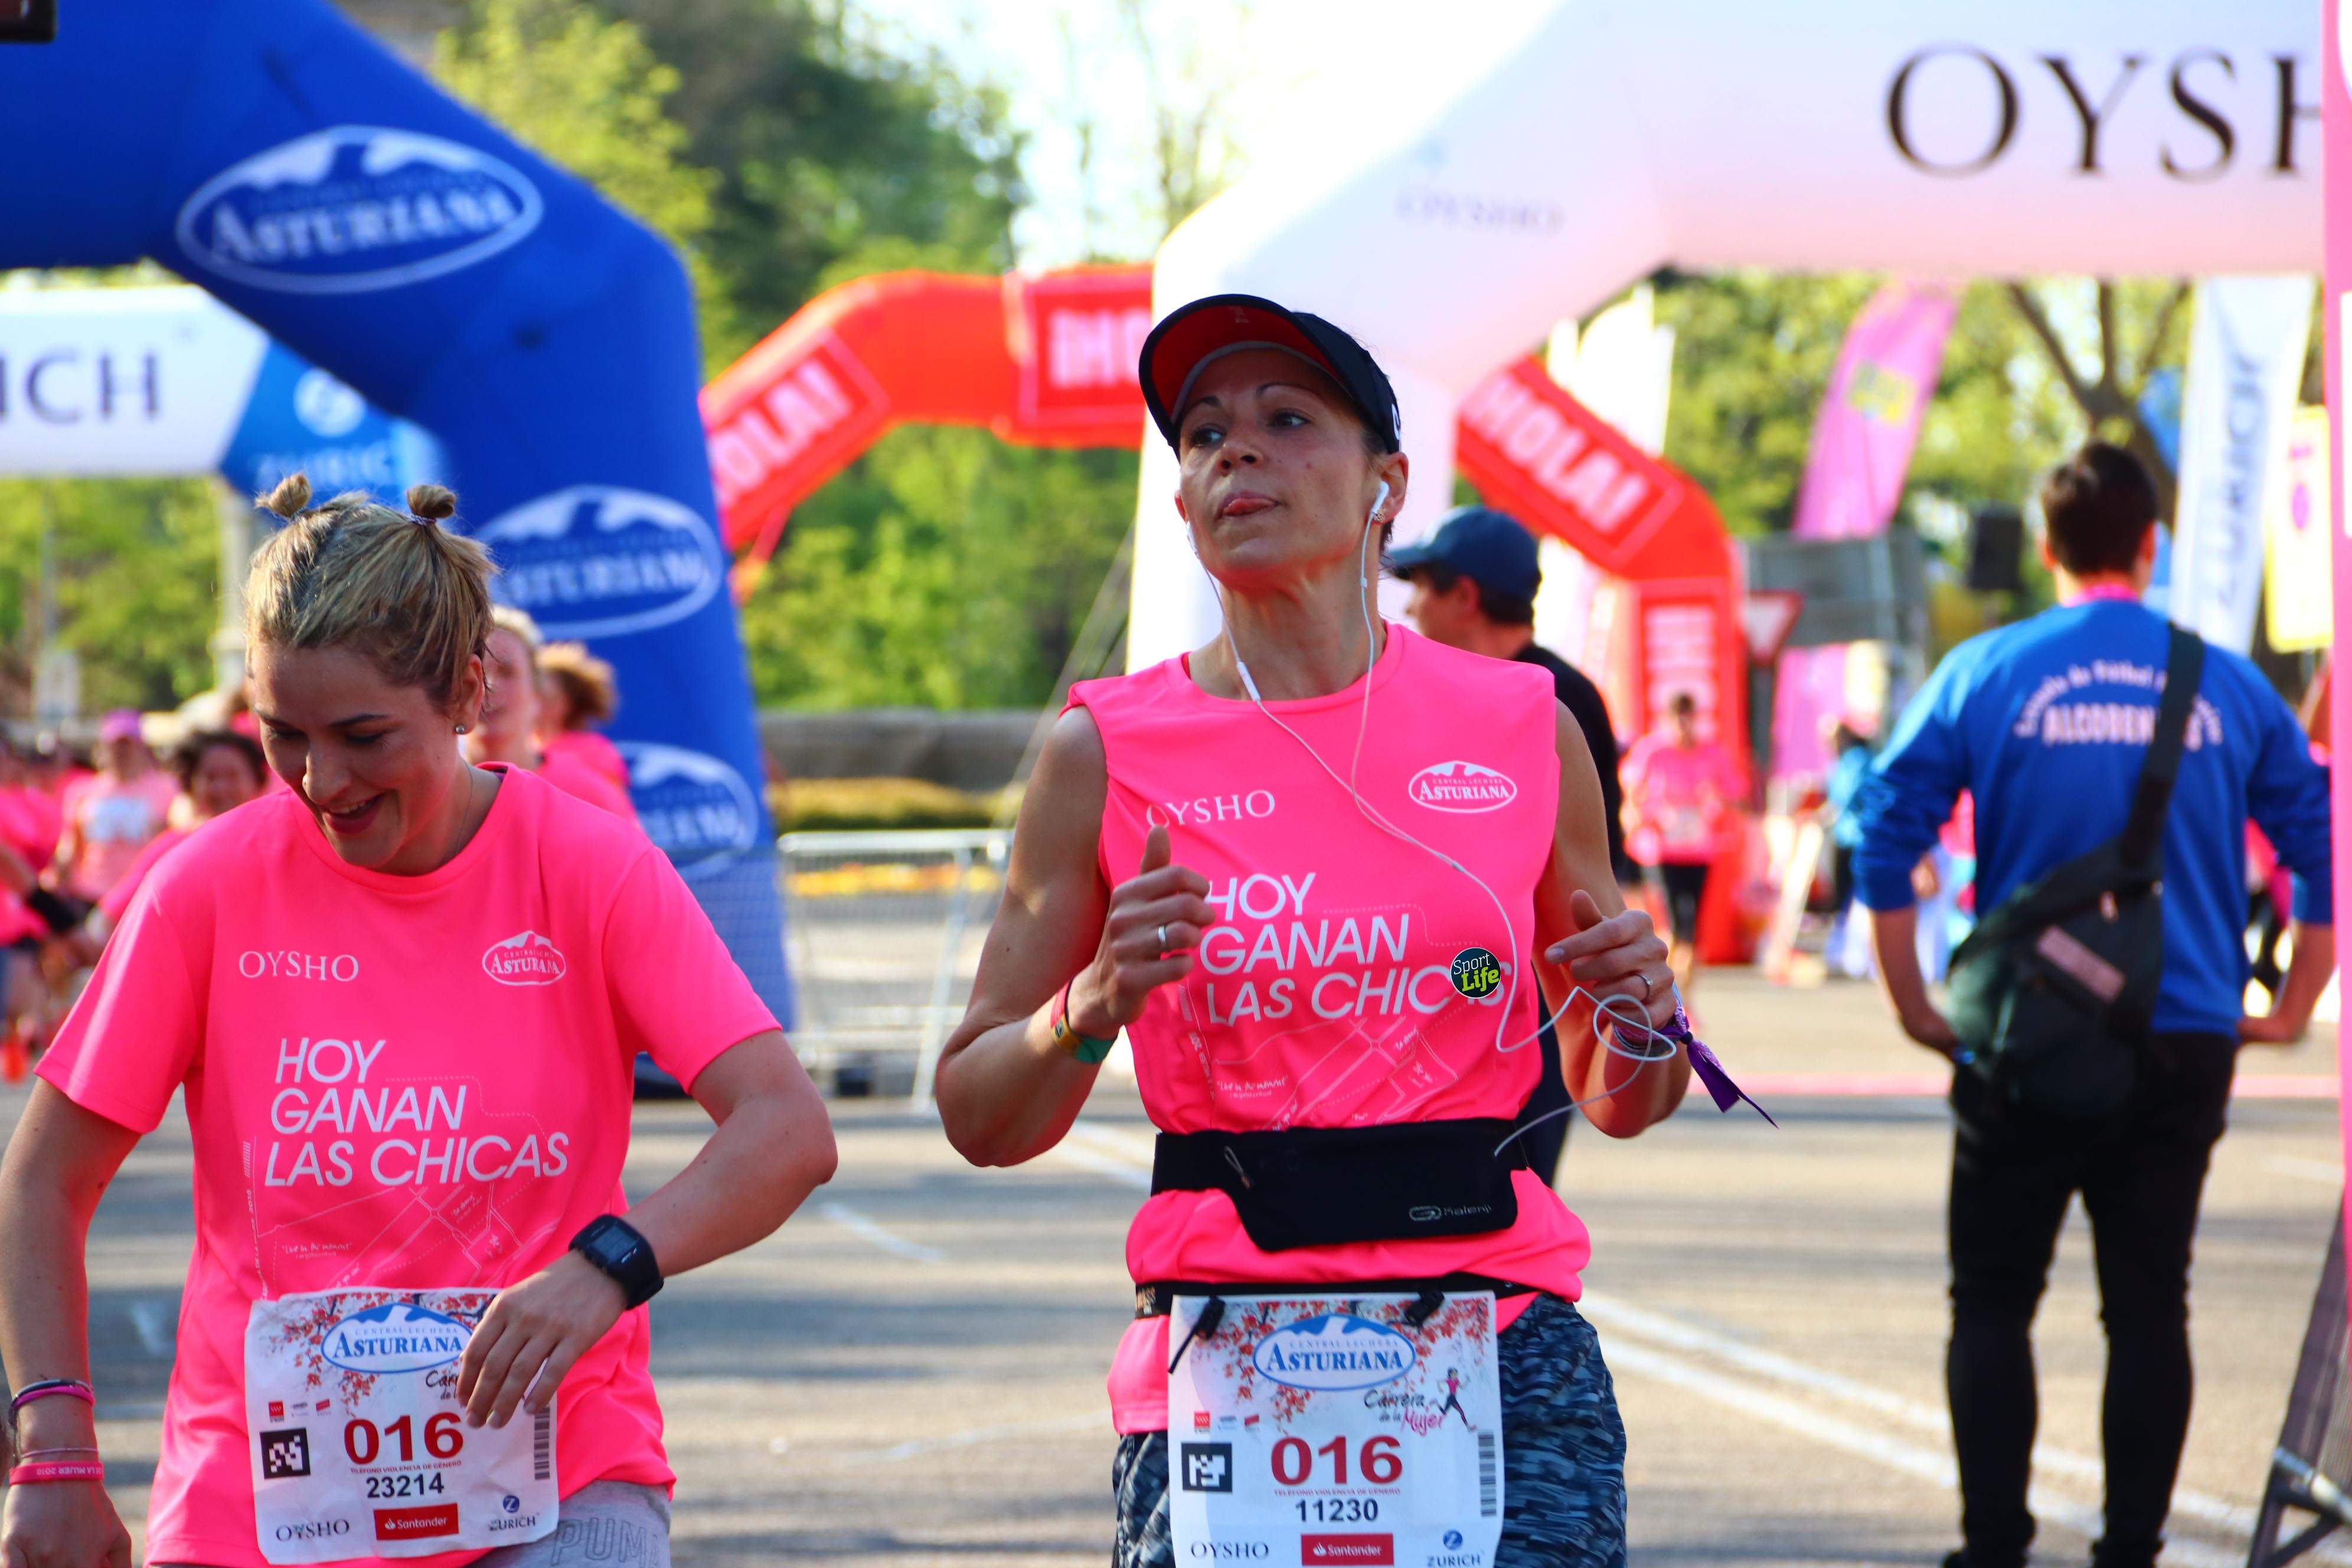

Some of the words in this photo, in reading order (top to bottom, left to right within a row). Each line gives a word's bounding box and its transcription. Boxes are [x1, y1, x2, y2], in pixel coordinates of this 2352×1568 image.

[1419, 779, 1510, 801] ASTURIANA
[1146, 789, 1276, 827] OYSHO
[1204, 872, 1317, 922] HOY
[1199, 913, 1409, 975] GANAN
[239, 950, 360, 982] OYSHO
[1453, 953, 1491, 975] Sport
[1461, 966, 1500, 992] Life
[1207, 977, 1296, 1027] LAS
[275, 1037, 386, 1084] HOY
[270, 1085, 466, 1135] GANAN
[264, 1140, 354, 1187] LAS
[370, 1132, 570, 1186] CHICAS
[334, 1332, 463, 1358] ASTURIANA
[355, 1327, 403, 1336] CENTRAL
[1290, 1339, 1341, 1348] CENTRAL
[1346, 1338, 1399, 1348] LECHERA
[1267, 1341, 1403, 1373] ASTURIANA
[344, 1411, 464, 1465] 016
[1271, 1435, 1403, 1485] 016
[366, 1472, 445, 1498] 23214
[1295, 1498, 1378, 1523] 11230
[275, 1518, 350, 1542] OYSHO
[397, 1516, 448, 1530] Santander
[489, 1516, 536, 1531] ZURICH
[1190, 1541, 1269, 1560] OYSHO
[1327, 1544, 1383, 1557] Santander
[1427, 1553, 1482, 1568] ZURICH
